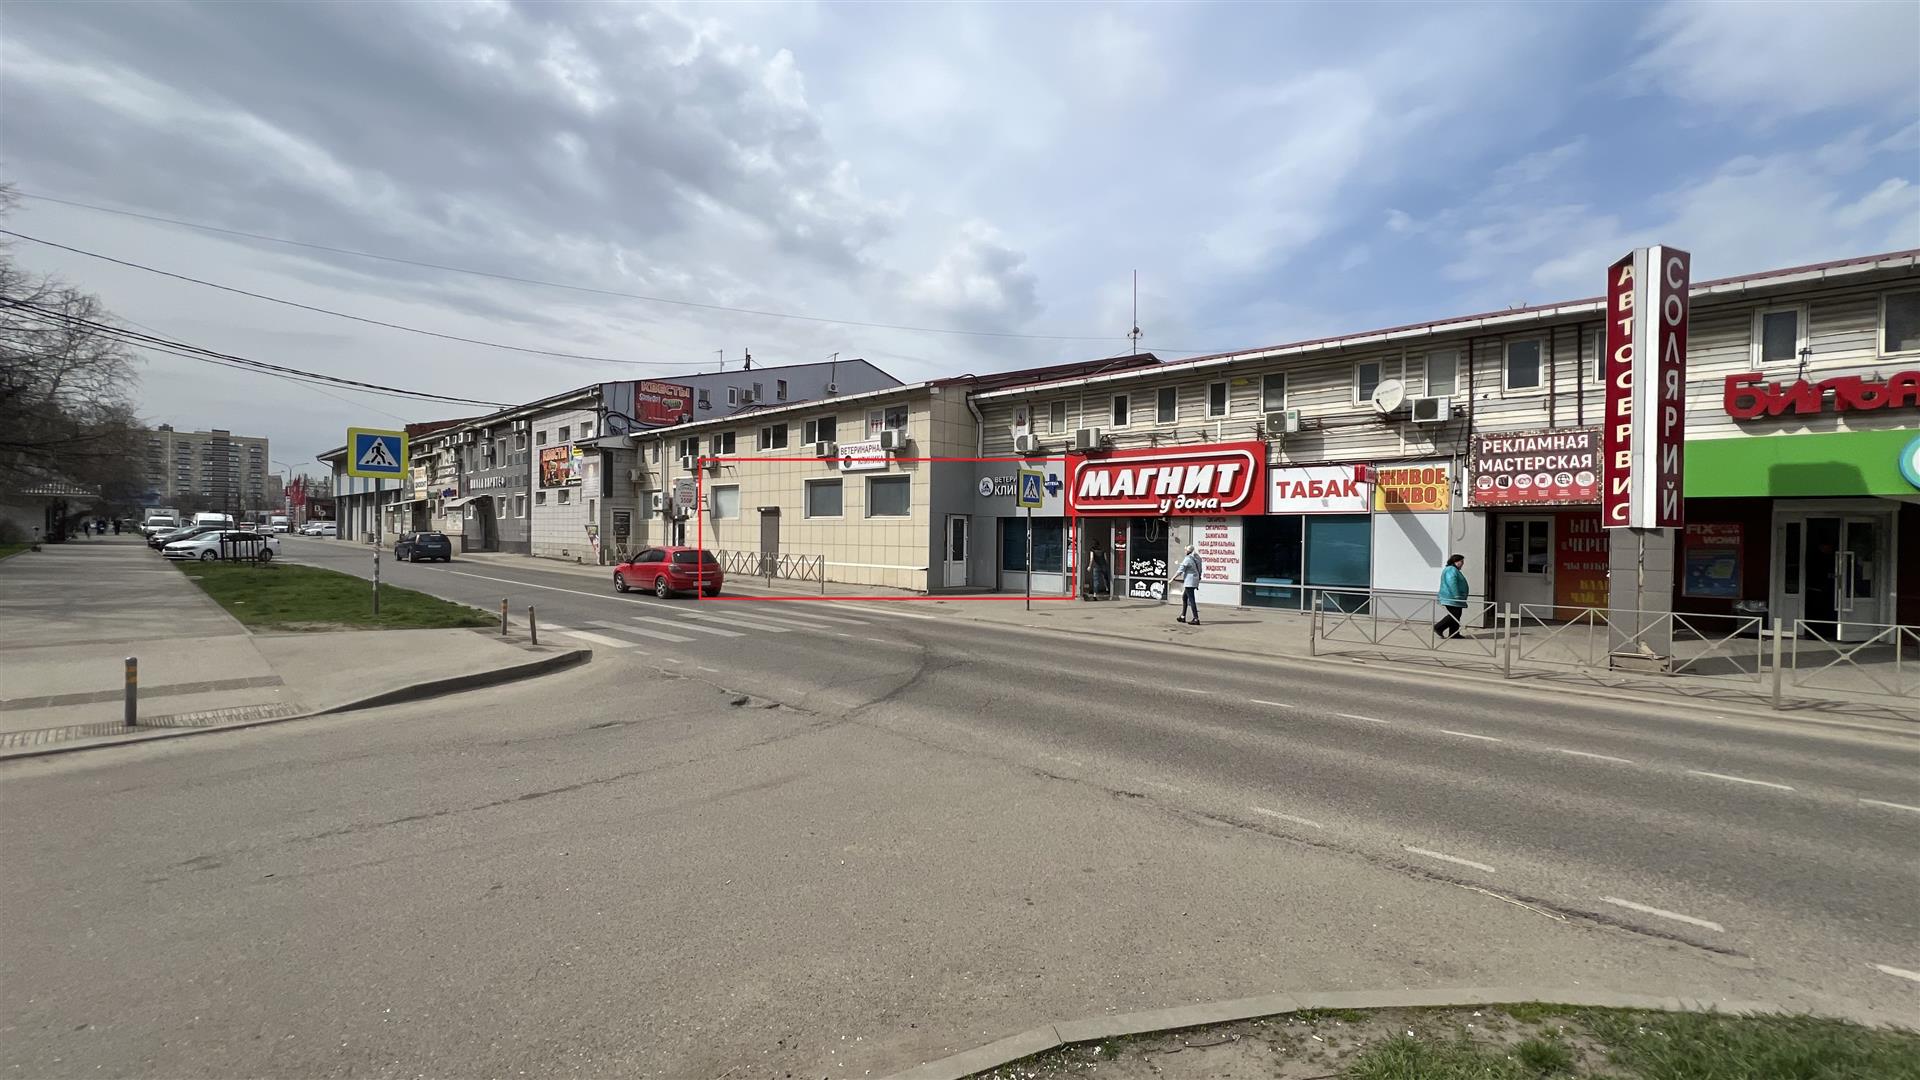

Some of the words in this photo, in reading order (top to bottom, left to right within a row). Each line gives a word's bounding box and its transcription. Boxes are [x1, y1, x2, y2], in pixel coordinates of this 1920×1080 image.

[640, 381, 690, 398] КВЕСТЫ
[1663, 256, 1685, 521] СОЛЯРИЙ
[1482, 434, 1590, 454] РЕКЛАМНАЯ
[1479, 454, 1593, 472] МАСТЕРСКАЯ
[1079, 463, 1240, 497] МАГНИТ
[1380, 468, 1446, 485] ЖИВОЕ
[1276, 479, 1360, 498] ТАБАК
[1386, 487, 1437, 503] ПИВО
[1175, 495, 1218, 509] дома
